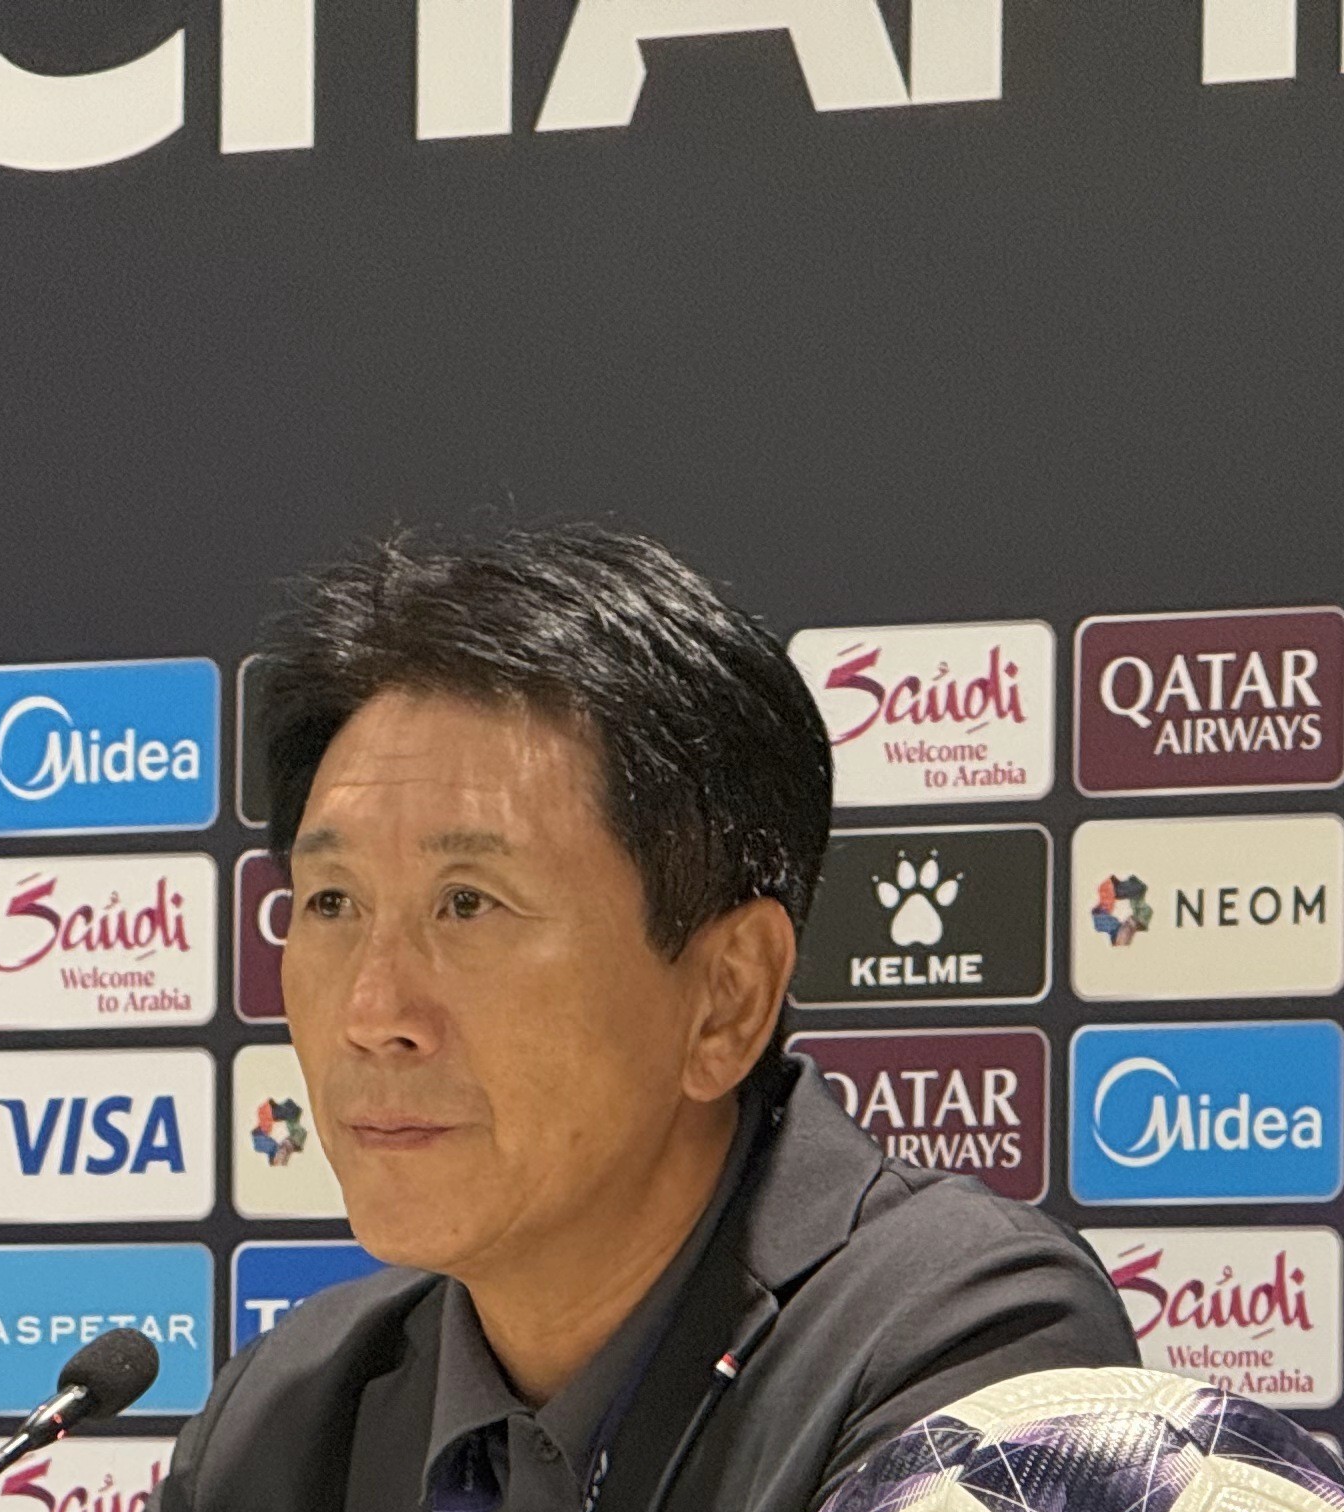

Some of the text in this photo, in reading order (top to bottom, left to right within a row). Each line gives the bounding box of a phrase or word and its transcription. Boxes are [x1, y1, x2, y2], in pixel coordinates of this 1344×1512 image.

[824, 643, 1027, 746] Saudi
[1101, 649, 1321, 728] QATAR
[1154, 714, 1322, 755] AIRWAYS
[6, 722, 200, 788] Midea
[884, 741, 988, 764] Welcome
[924, 763, 1027, 788] to Arabia
[1176, 886, 1326, 928] NEOM
[59, 966, 155, 989] Welcome
[851, 955, 984, 985] KELME
[97, 989, 192, 1012] to Arabia
[1105, 1086, 1324, 1156] Midea
[871, 1133, 1022, 1168] IRWAYS
[1167, 1345, 1273, 1368] Welcome
[1239, 1369, 1314, 1393] Arabia
